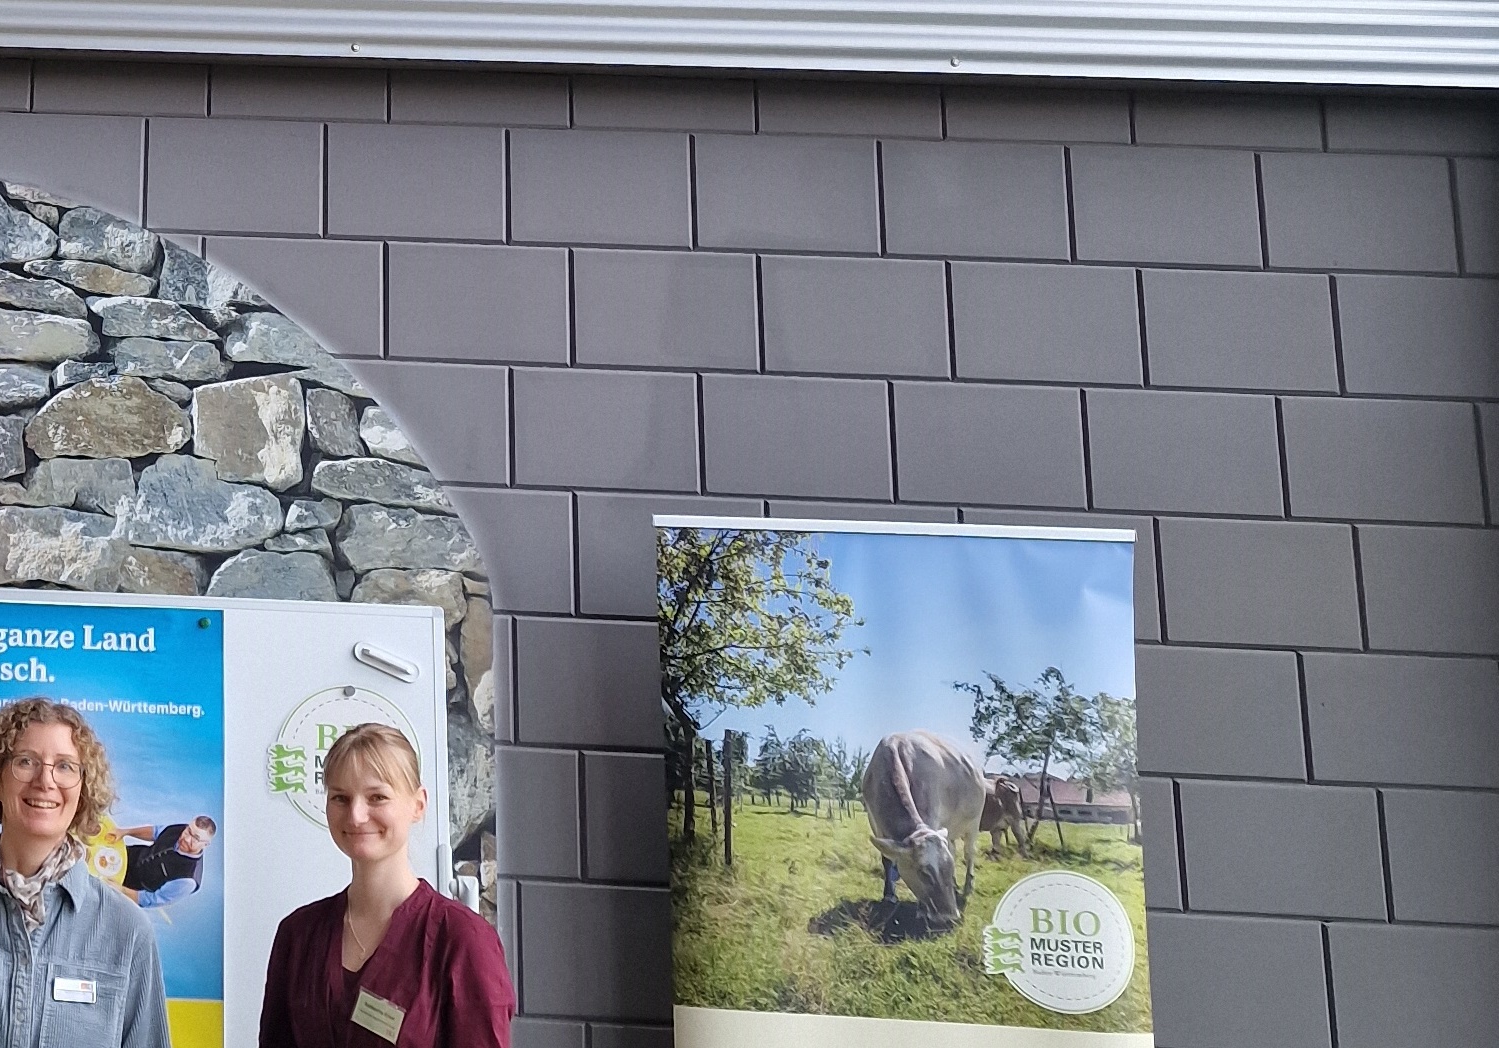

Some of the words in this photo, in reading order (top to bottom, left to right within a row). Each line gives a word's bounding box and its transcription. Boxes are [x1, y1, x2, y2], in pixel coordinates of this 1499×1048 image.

[82, 624, 156, 652] Land
[1029, 907, 1101, 937] BIO
[1030, 936, 1104, 956] MUSTER
[1030, 952, 1105, 971] REGION
